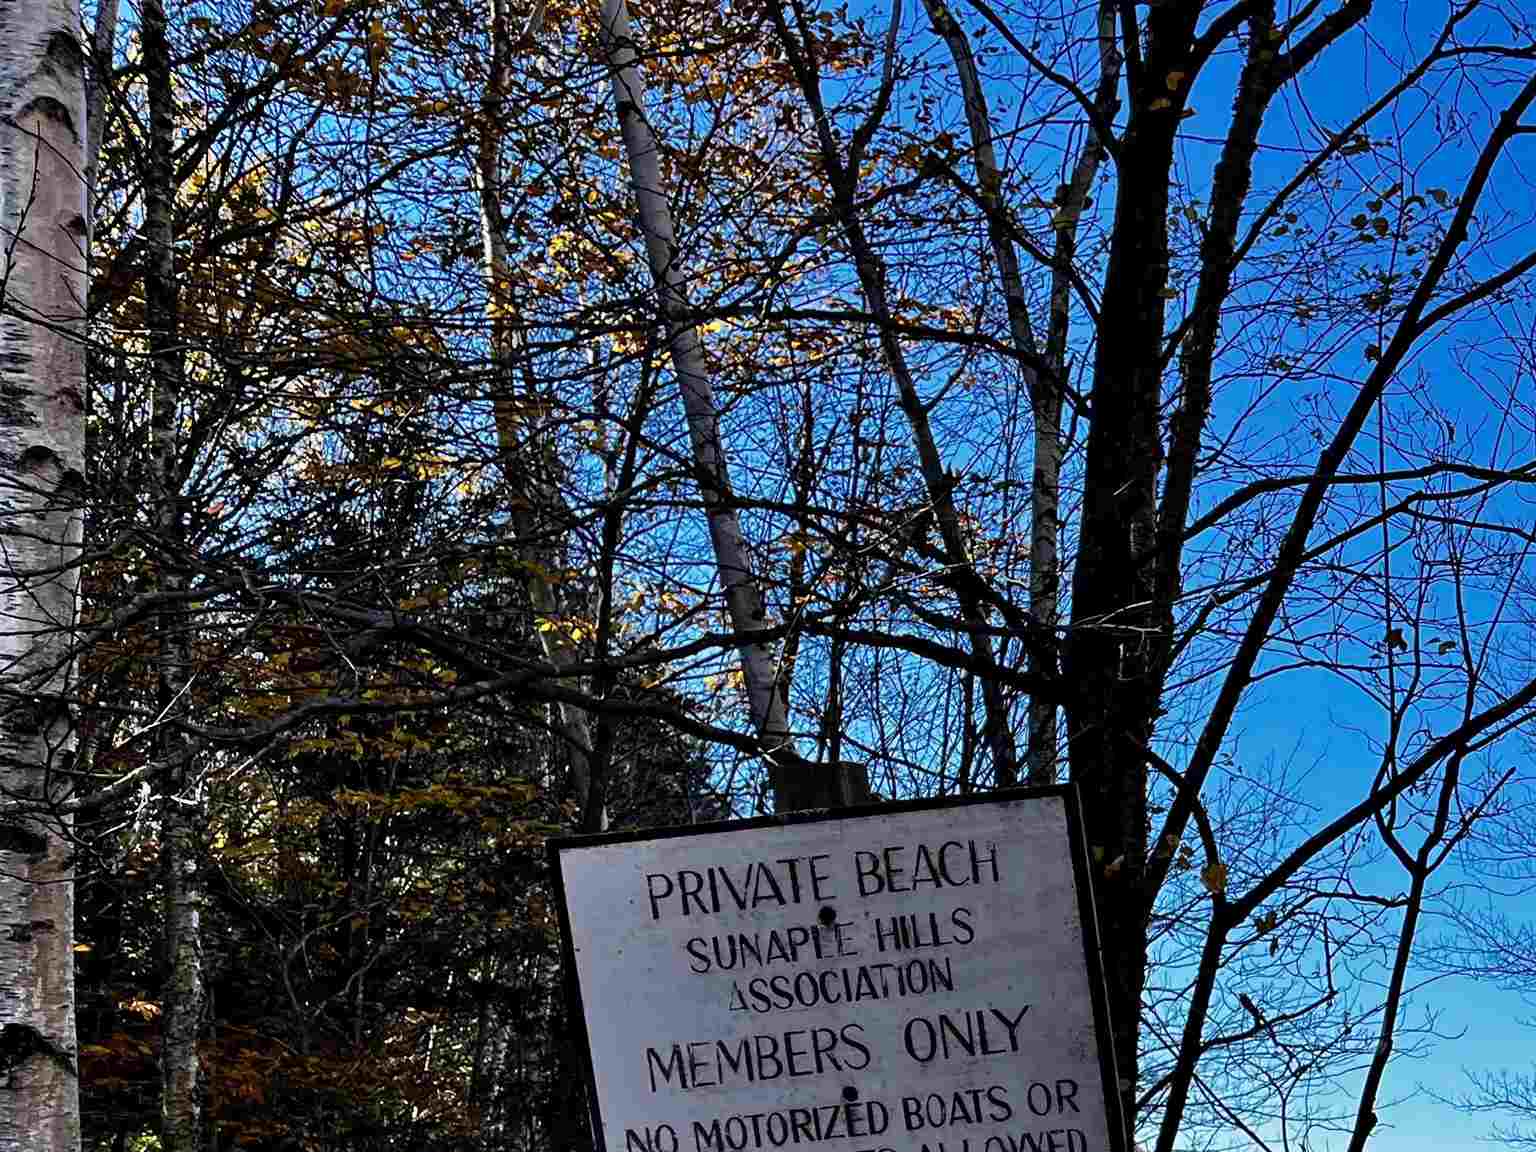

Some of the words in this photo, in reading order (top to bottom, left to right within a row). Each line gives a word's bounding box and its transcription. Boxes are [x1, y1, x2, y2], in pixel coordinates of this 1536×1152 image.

[647, 854, 837, 920] PRIVATE
[855, 840, 1000, 897] BEACH
[875, 908, 976, 953] HILLS
[728, 957, 954, 1013] ASSOCIATION
[647, 1023, 872, 1093] MEMBERS
[904, 1004, 1032, 1063] ONLY
[694, 1100, 889, 1152] MOTORIZED
[903, 1085, 1013, 1132] BOATS
[1027, 1079, 1081, 1118] OR
